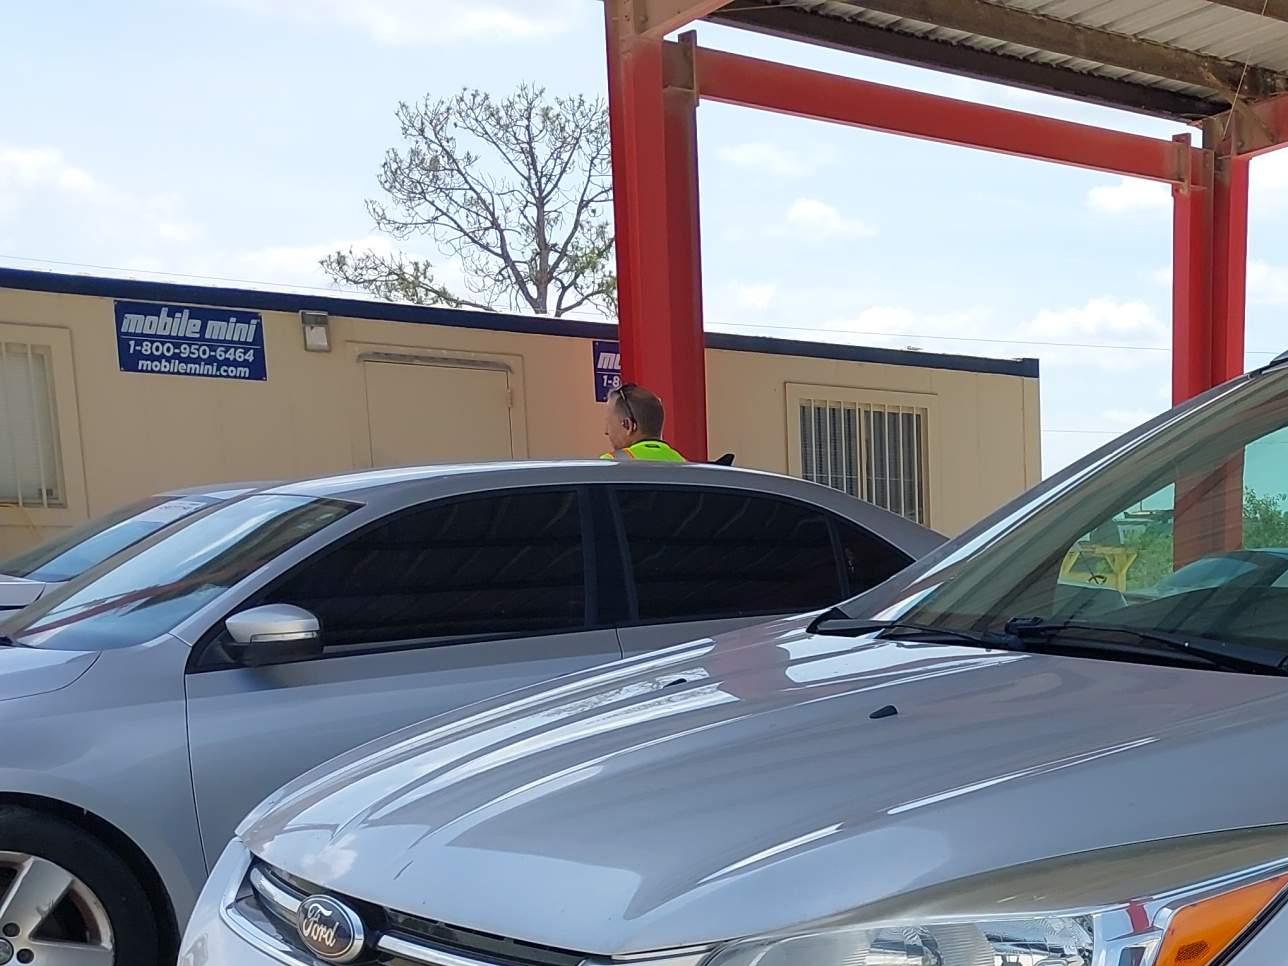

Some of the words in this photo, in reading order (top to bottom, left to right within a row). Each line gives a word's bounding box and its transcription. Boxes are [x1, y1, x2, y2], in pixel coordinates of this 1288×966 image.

[121, 307, 202, 337] mobile
[204, 317, 258, 342] mini
[128, 340, 255, 362] 1-800-950-6464
[137, 360, 250, 378] mobilemini.com
[302, 903, 340, 948] Ford
